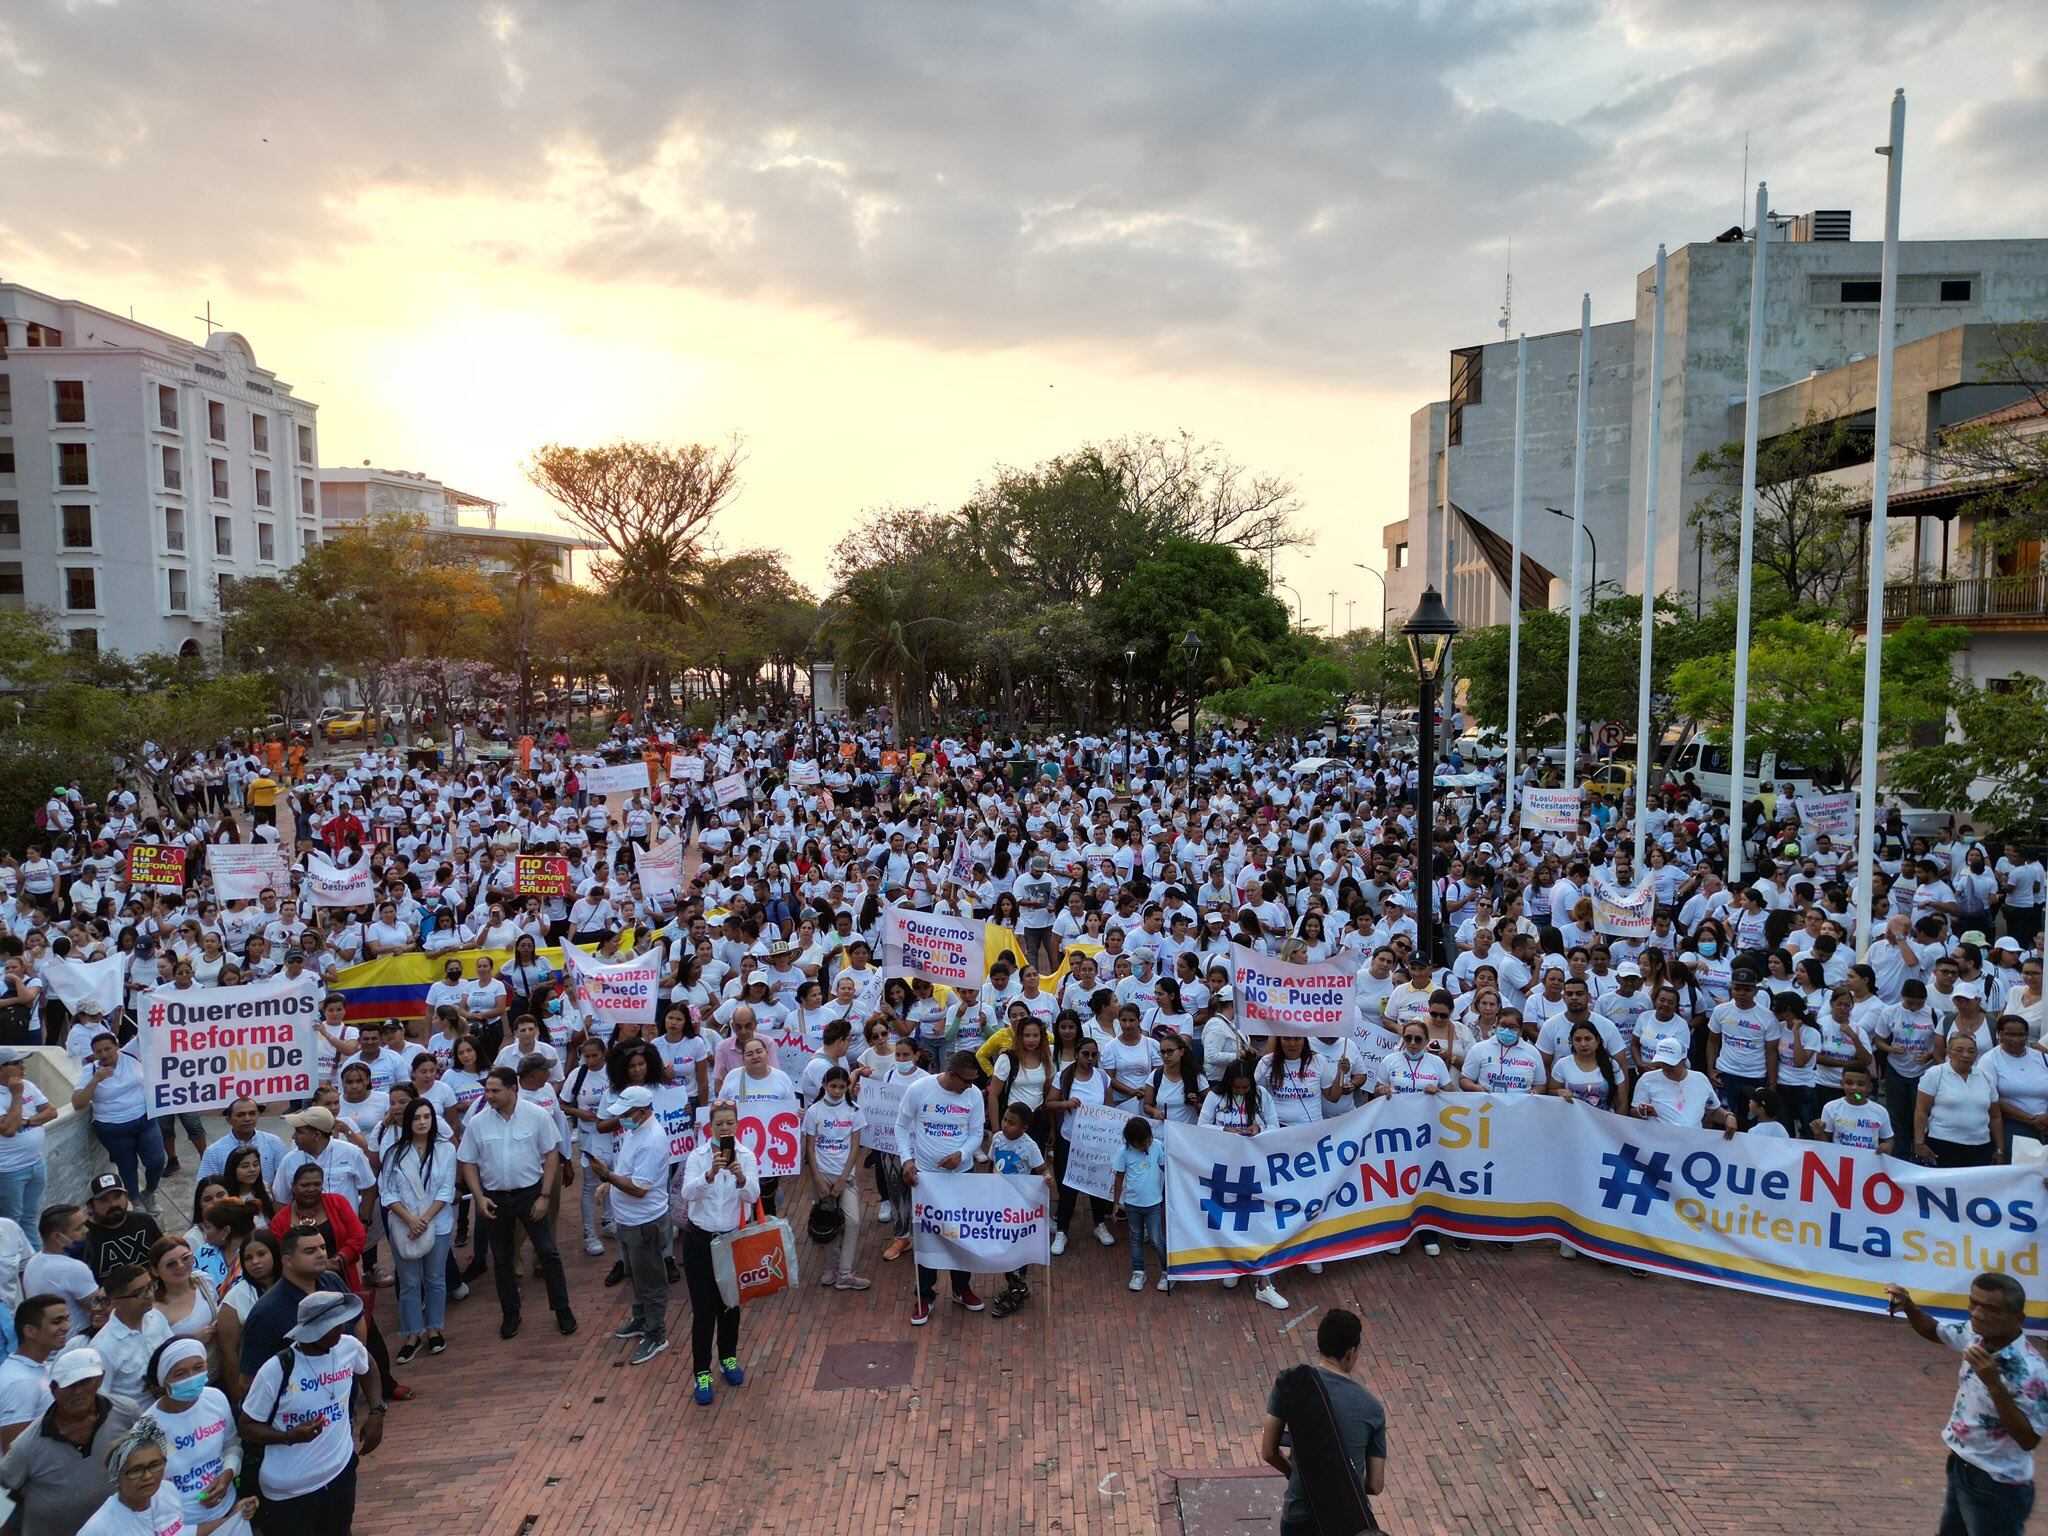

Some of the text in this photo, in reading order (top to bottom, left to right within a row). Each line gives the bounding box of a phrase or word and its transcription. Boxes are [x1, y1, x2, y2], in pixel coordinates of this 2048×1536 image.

[133, 847, 158, 858] NO
[132, 862, 182, 871] REFORMA
[519, 859, 542, 869] NO
[131, 874, 176, 884] SALUD
[519, 885, 558, 894] SALUD
[898, 918, 975, 941] #Queremos
[907, 932, 963, 953] Reforma
[902, 955, 966, 979] EsaForma
[1236, 967, 1354, 988] #ParaAvanzar
[1244, 986, 1344, 1006] NoSePuede
[148, 995, 315, 1027] #Queremos
[1245, 1002, 1343, 1023] Retroceder
[170, 1024, 294, 1054] Reforma
[161, 1045, 303, 1080] PeroNoDe
[154, 1073, 310, 1109] EstaForma
[914, 1203, 1044, 1226] #ConstruyeSalud
[920, 1219, 1037, 1244] NoLaDestruyan
